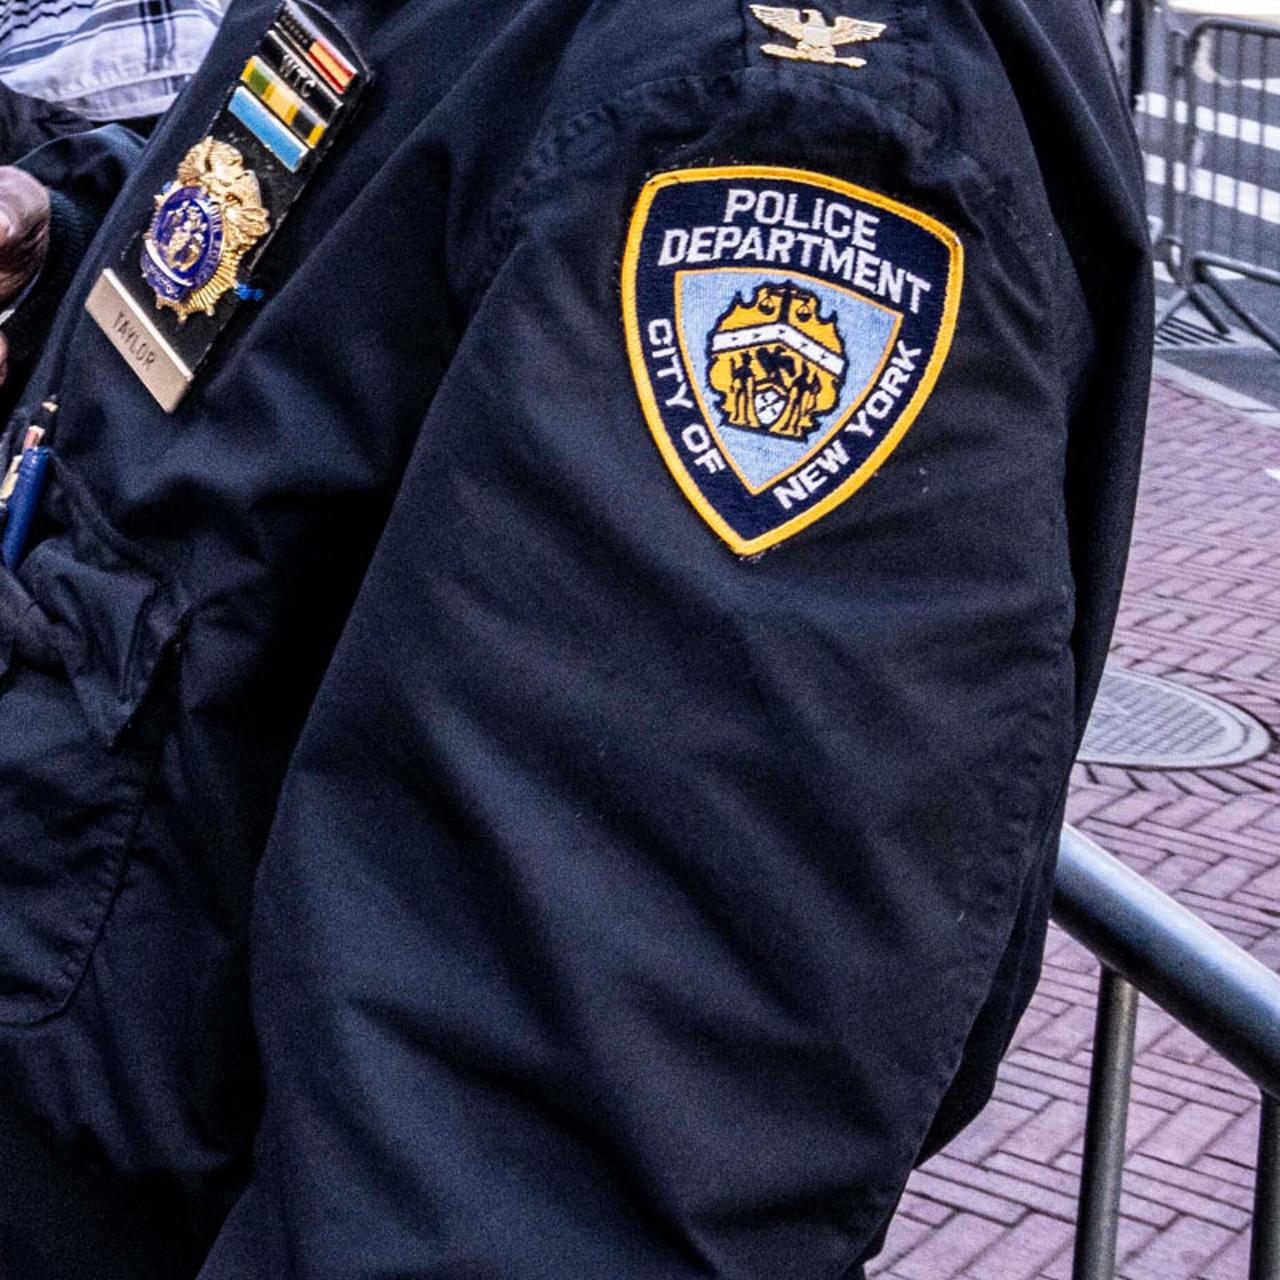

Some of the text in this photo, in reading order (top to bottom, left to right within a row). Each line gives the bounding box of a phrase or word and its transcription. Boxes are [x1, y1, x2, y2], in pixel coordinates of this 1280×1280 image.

[279, 53, 318, 99] WTC
[724, 189, 880, 251] POLICE
[658, 226, 931, 314] DEPARTMENT
[112, 310, 155, 371] TAYLOR
[647, 318, 727, 475] CITY OF
[772, 339, 922, 510] NEW YORK
